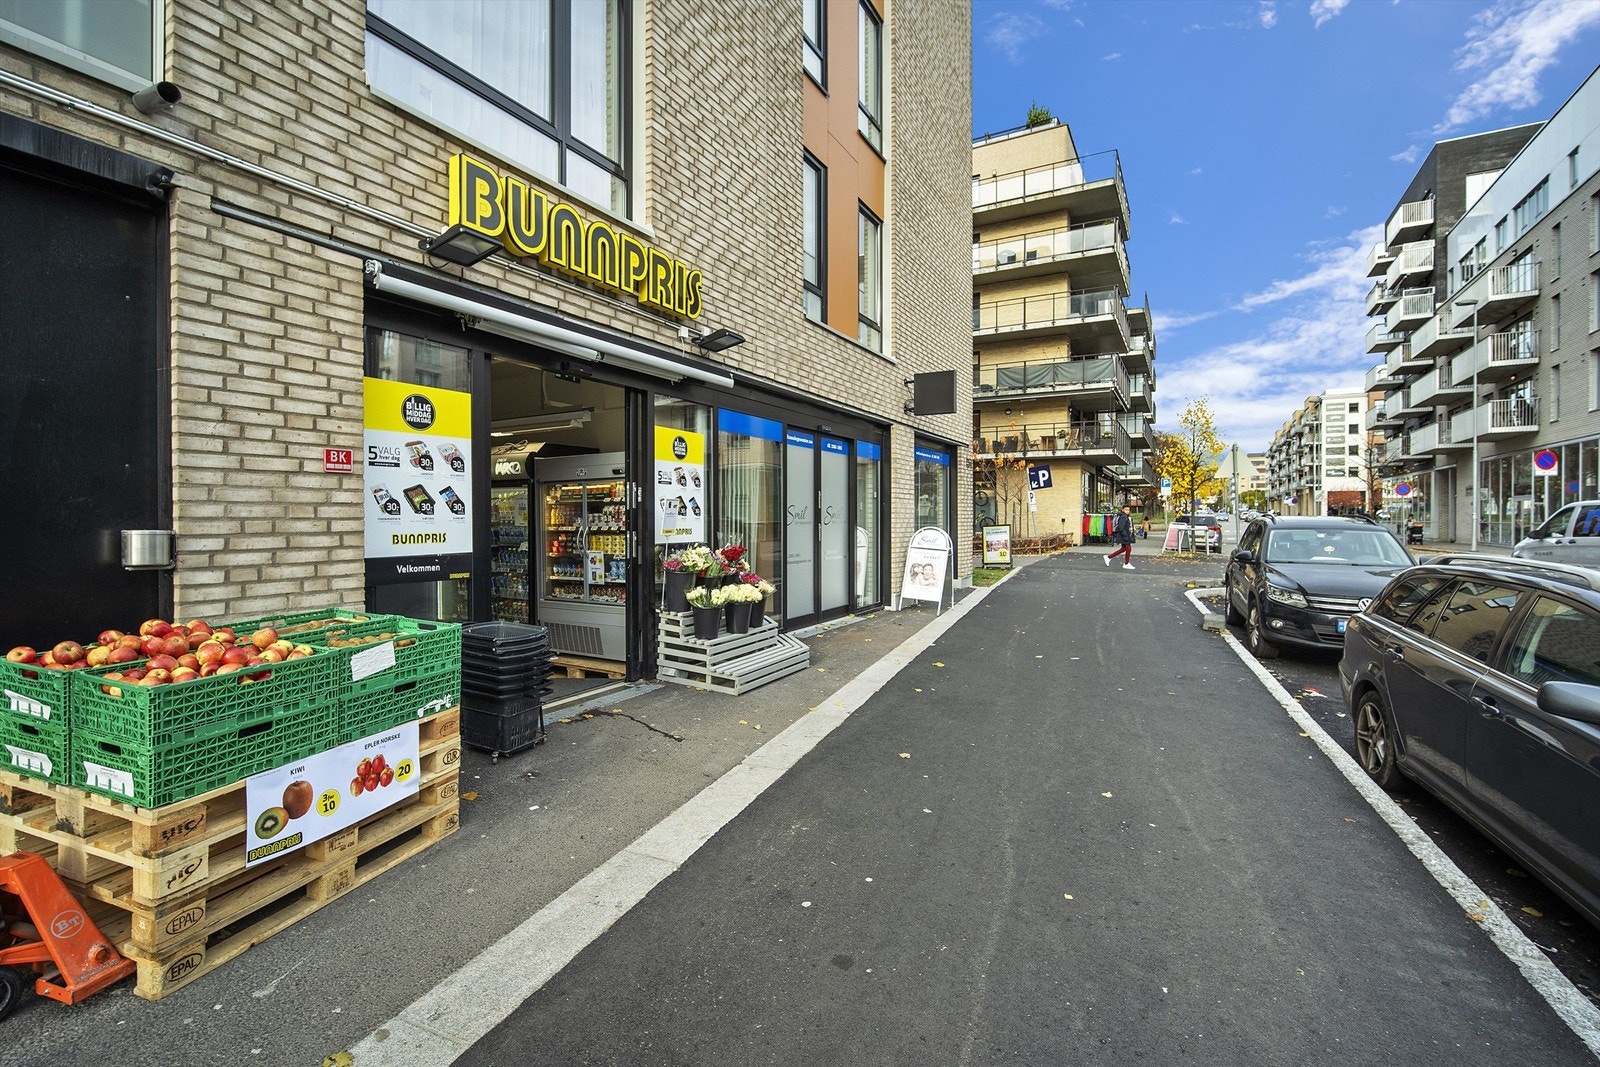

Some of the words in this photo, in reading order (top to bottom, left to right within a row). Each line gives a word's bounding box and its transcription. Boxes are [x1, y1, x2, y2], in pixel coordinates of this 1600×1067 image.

[450, 153, 702, 320] BUNNPRIS
[405, 397, 432, 411] BILLIG
[405, 409, 432, 418] MIDDAG
[420, 417, 432, 425] DAG
[330, 450, 347, 463] BK
[368, 445, 378, 461] 5
[378, 446, 401, 456] VALG
[1038, 469, 1049, 487] P
[1163, 479, 1169, 487] P
[1029, 492, 1034, 502] P
[392, 533, 447, 545] BUNNPRIS
[396, 565, 441, 574] Velkommen
[364, 739, 381, 750] EPLER
[380, 732, 402, 746] NORSKE
[446, 749, 458, 764] EUR
[289, 765, 306, 776] KIWI
[397, 763, 411, 778] 20
[323, 801, 336, 813] 10
[249, 832, 303, 862] BUNNPRIS
[55, 914, 80, 932] BT
[171, 910, 197, 933] EPAL
[171, 957, 197, 980] EPAL
